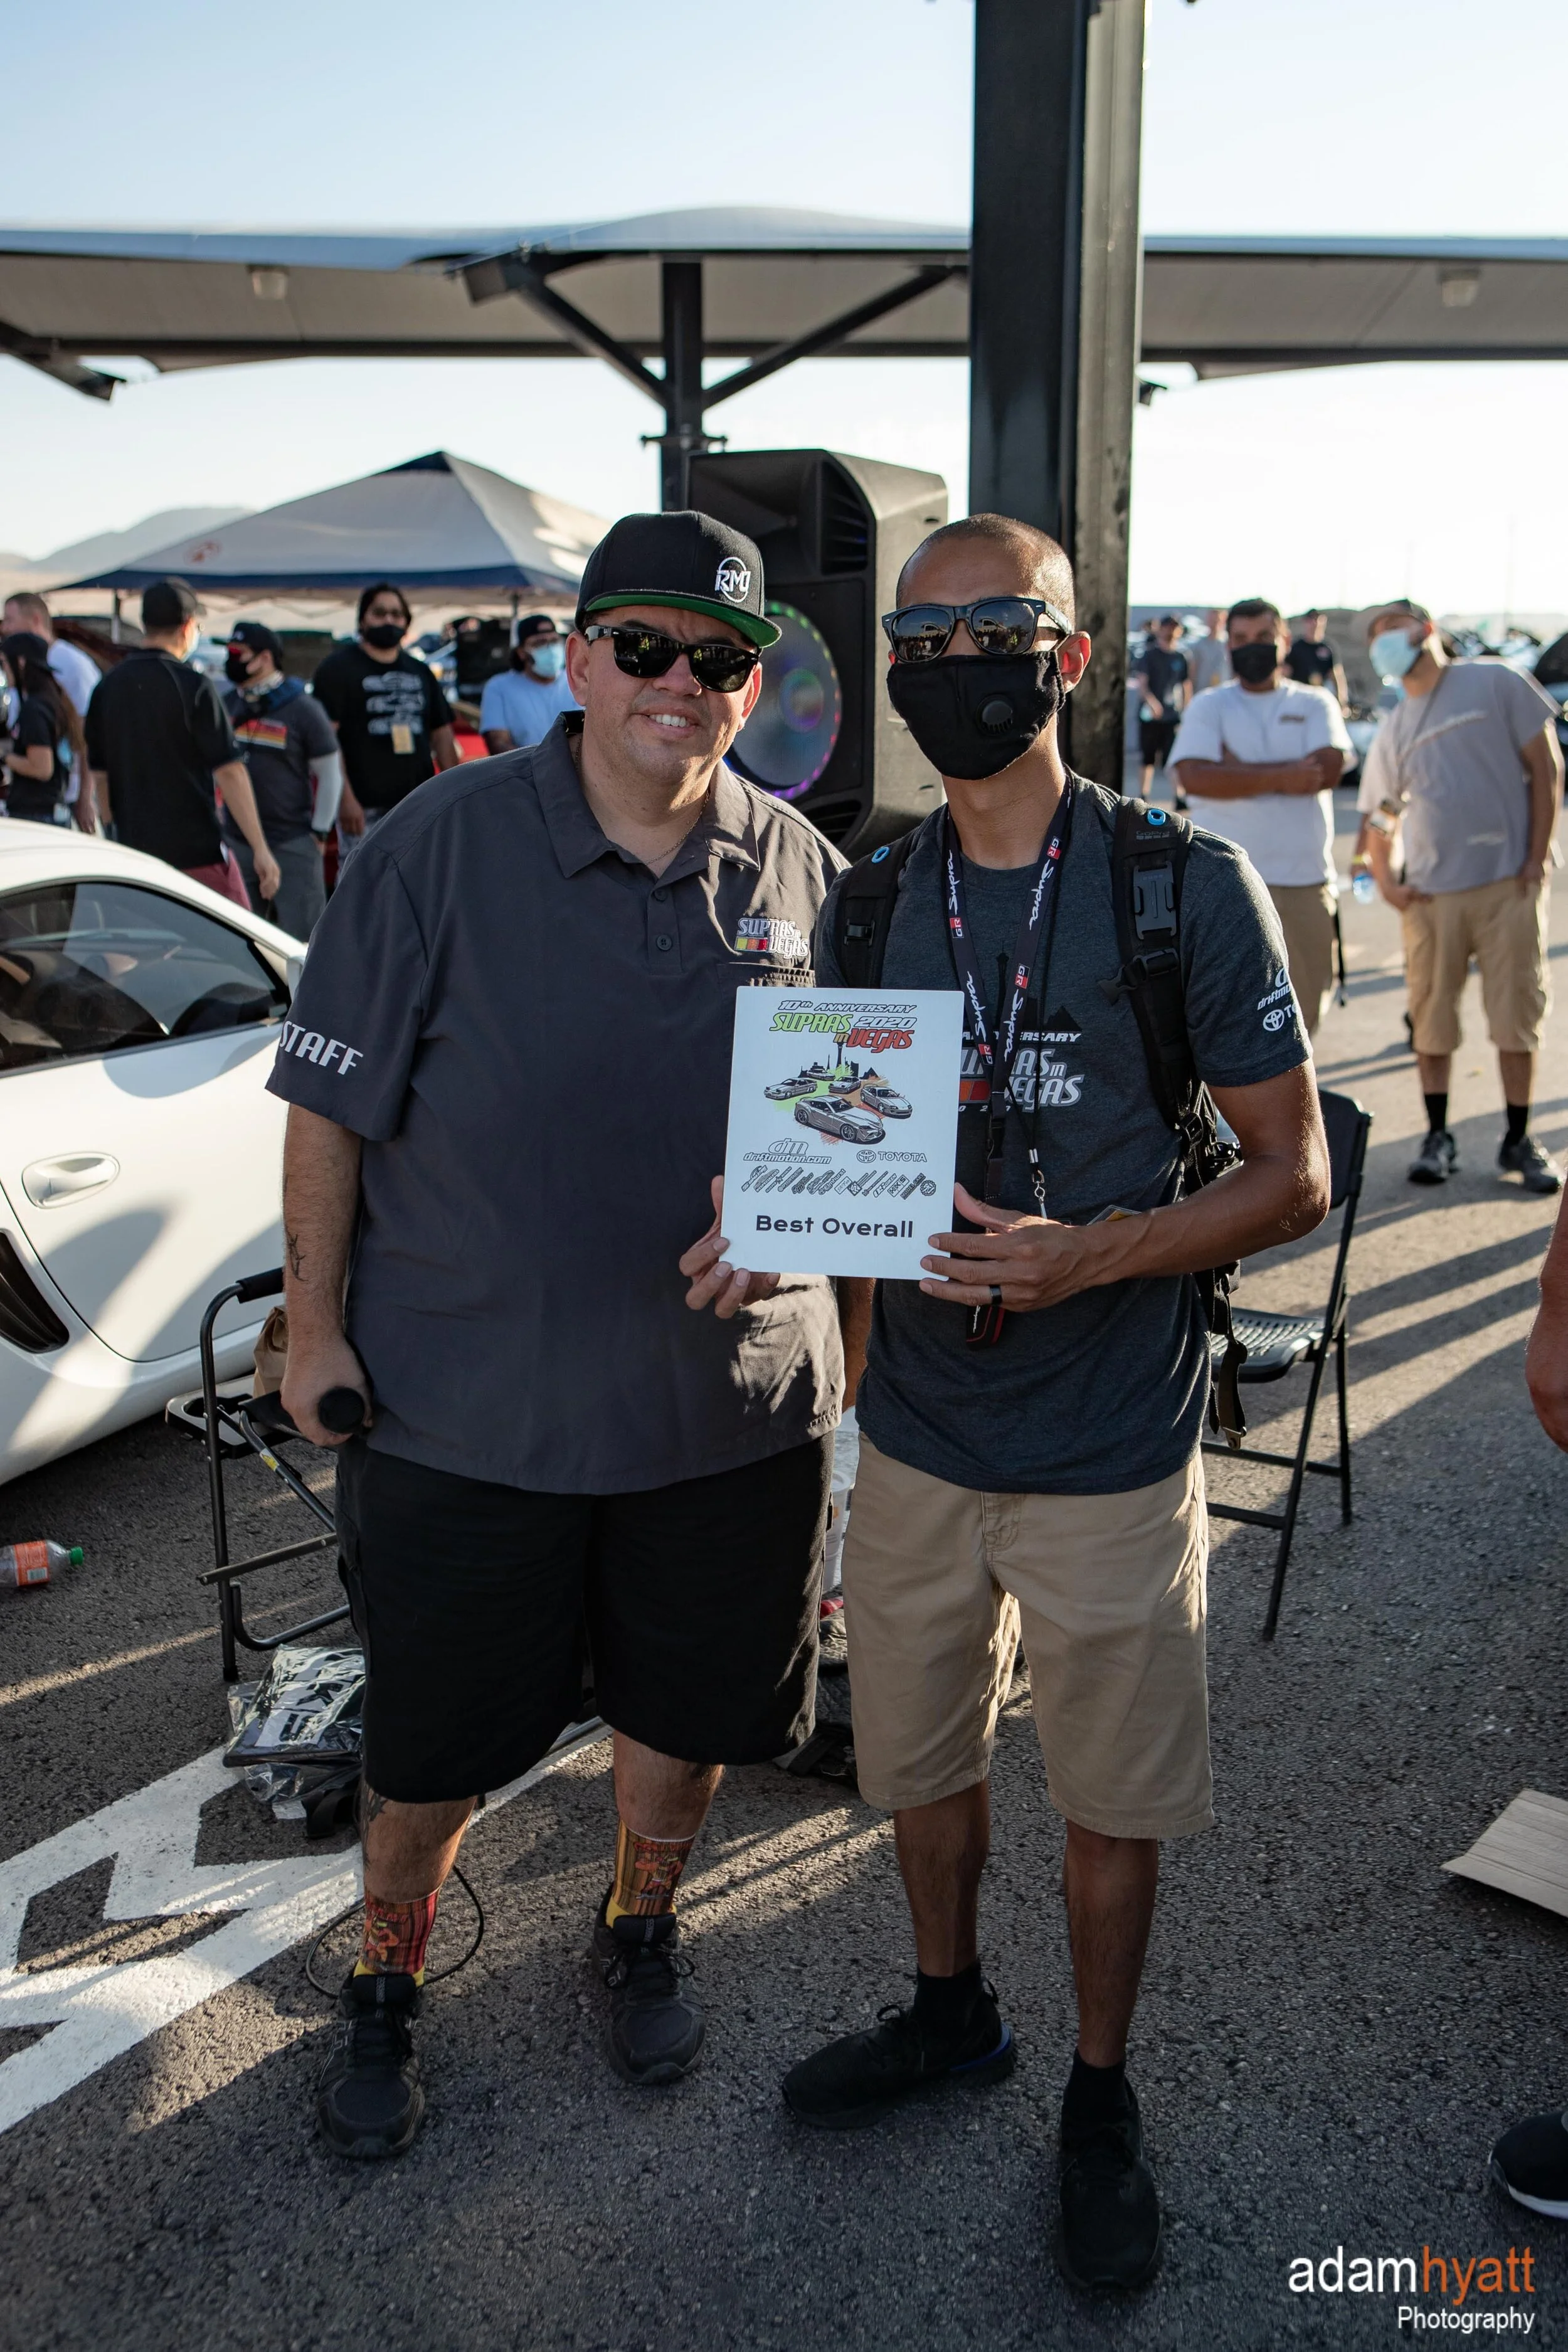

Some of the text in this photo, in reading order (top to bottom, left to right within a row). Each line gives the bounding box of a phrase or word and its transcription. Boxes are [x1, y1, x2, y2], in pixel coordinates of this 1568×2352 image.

[1049, 837, 1059, 857] GR
[947, 849, 961, 915] Supra
[1029, 859, 1054, 931] Supra
[737, 918, 795, 938] SUPRAS
[954, 919, 963, 937] GR
[768, 936, 808, 959] VEGAS
[1015, 965, 1025, 987] GR
[778, 1000, 918, 1014] 10th ANNIVERSARY
[967, 971, 987, 1042] Supra
[770, 1012, 918, 1033] SUPRAS 2020
[1004, 988, 1024, 1062] Supra
[280, 1020, 364, 1075] STAFF
[846, 1029, 915, 1054] VEGAS
[983, 1046, 993, 1065] GR
[1049, 1064, 1066, 1076] in
[743, 1152, 832, 1165] driftmotion.com
[878, 1151, 928, 1162] TOYOTA
[824, 1168, 846, 1192] Elmhurst
[889, 1175, 908, 1195] HKS
[756, 1215, 913, 1238] Best Overall
